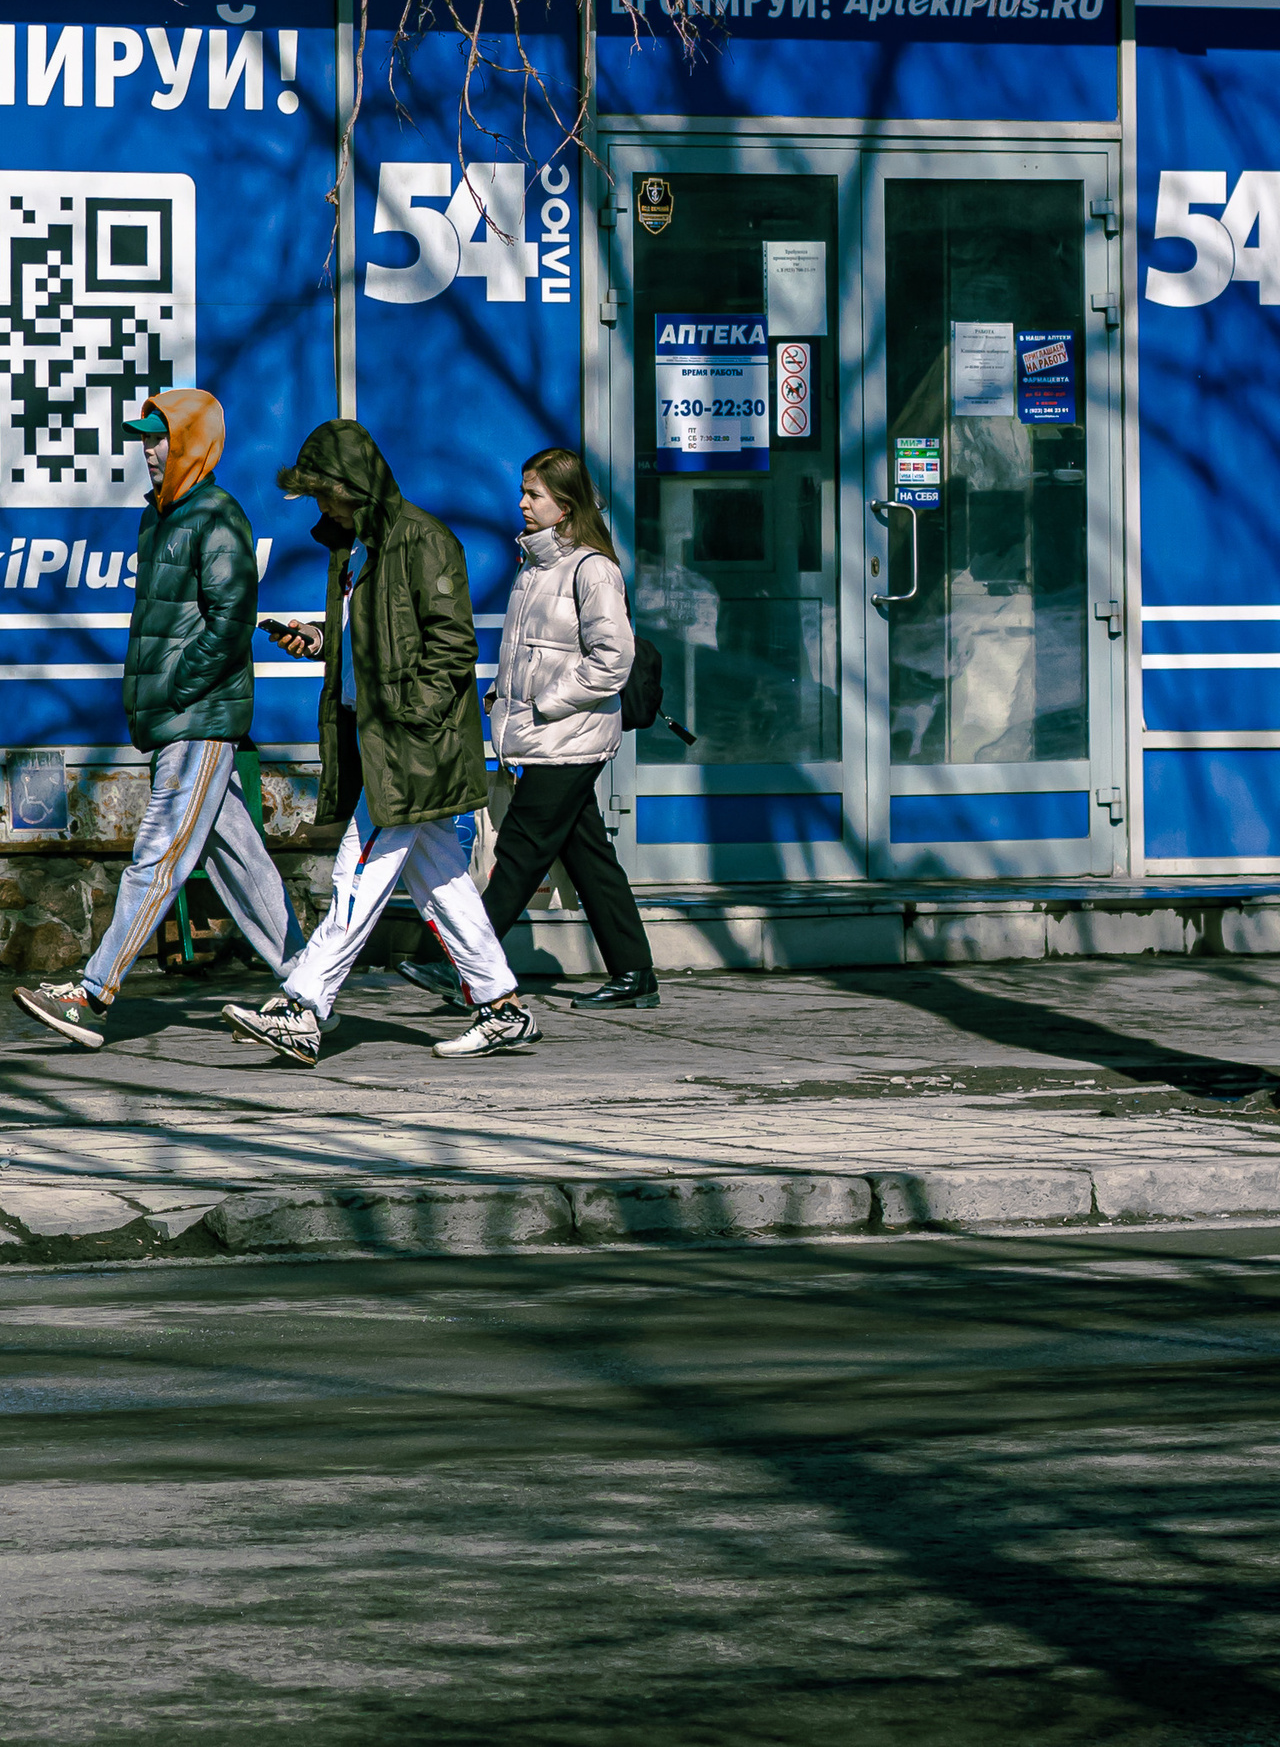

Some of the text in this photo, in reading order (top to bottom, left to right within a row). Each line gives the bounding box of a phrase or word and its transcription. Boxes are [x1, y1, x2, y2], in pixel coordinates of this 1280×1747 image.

[364, 162, 539, 304] 54
[541, 164, 570, 303] ПЛЮС
[1145, 170, 1280, 308] 54
[659, 323, 766, 345] АПТЕКА
[1038, 351, 1068, 369] РАБОТУ
[681, 369, 744, 377] ВРЕМЯ РАБОТЫ
[661, 399, 766, 417] 7:30-22:30
[900, 491, 939, 501] НА СЕБЯ
